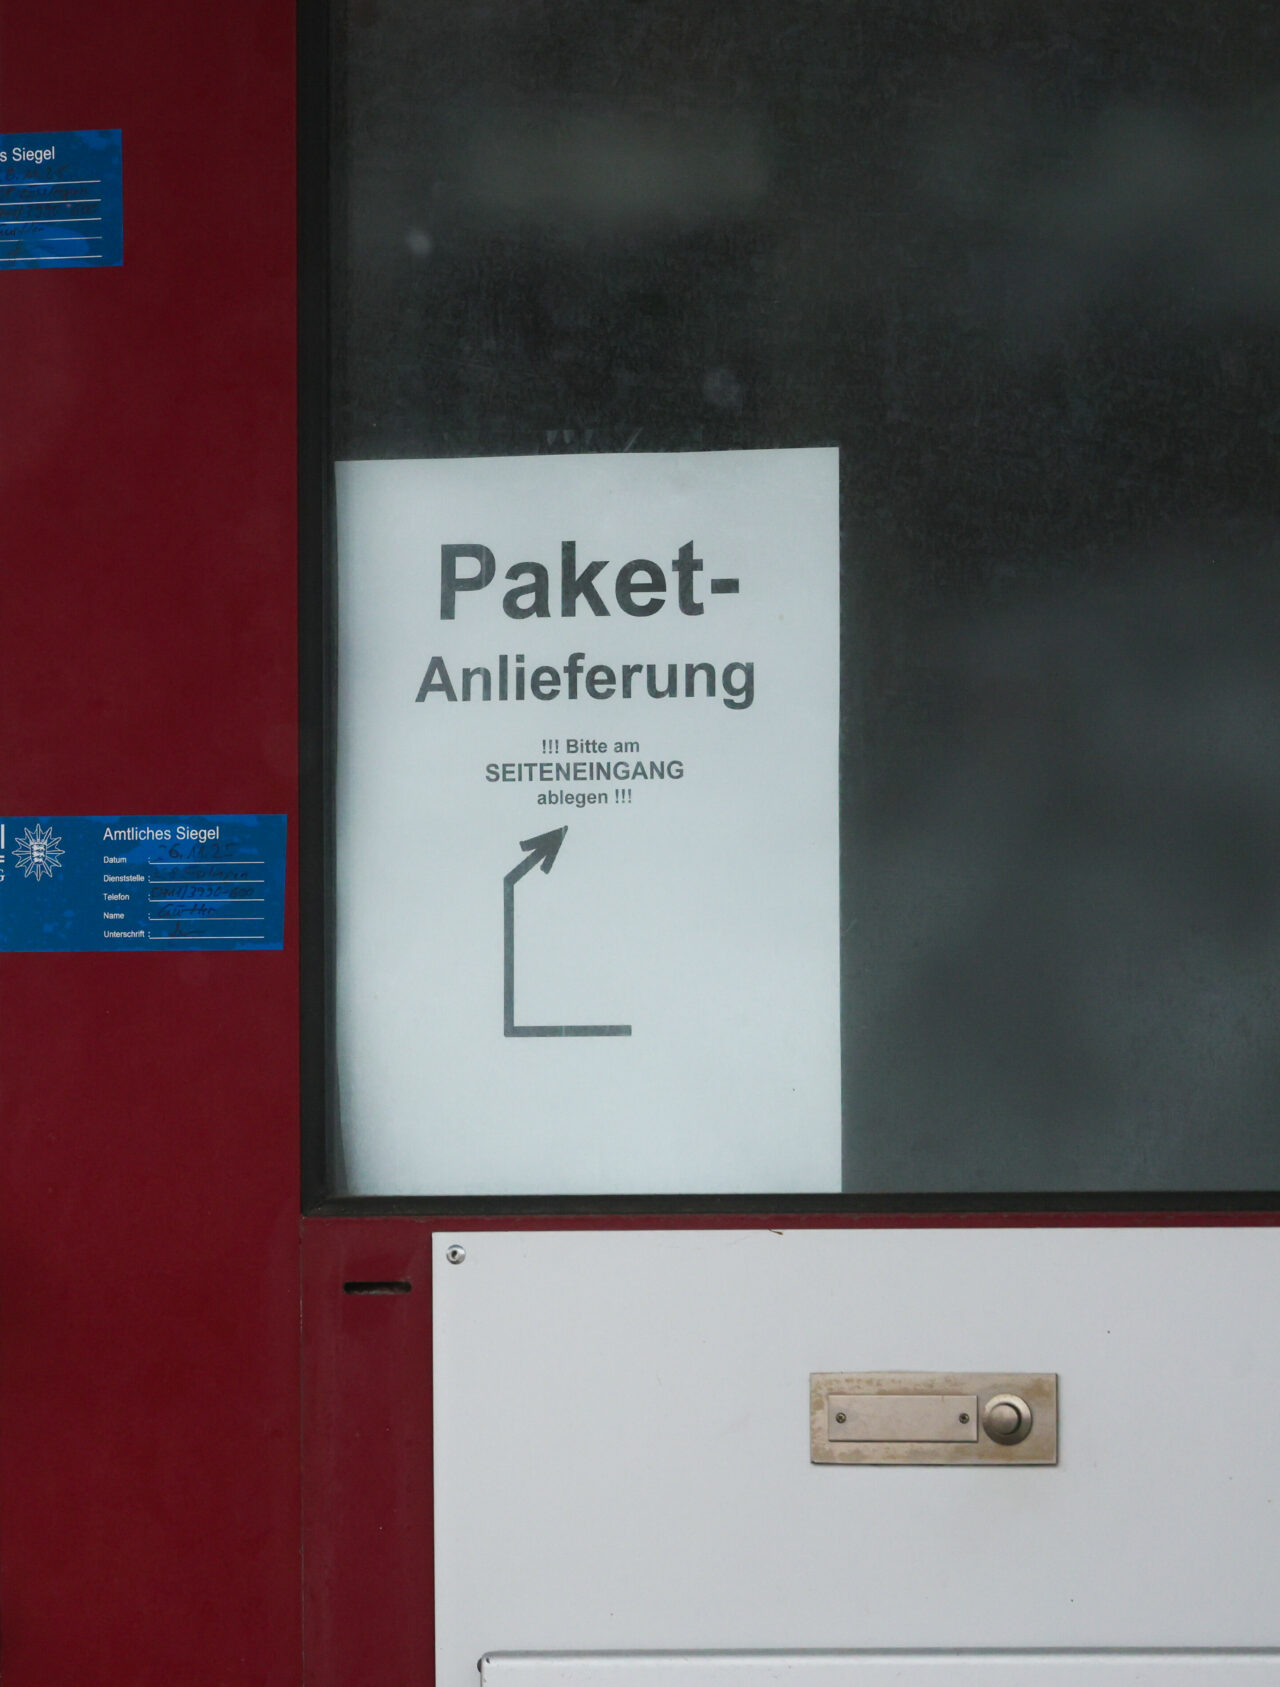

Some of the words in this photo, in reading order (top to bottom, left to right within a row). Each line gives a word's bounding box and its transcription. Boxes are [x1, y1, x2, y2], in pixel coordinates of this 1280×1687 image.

[12, 146, 56, 165] Siegel
[440, 539, 740, 620] Paket-
[415, 652, 755, 710] Anlieferung
[542, 739, 559, 754] !!!
[567, 738, 608, 754] Bitte
[614, 741, 640, 753] am
[485, 760, 684, 782] SEITENEINGANG
[537, 788, 608, 808] ablegen
[615, 788, 632, 804] !!!
[103, 827, 171, 840] Amtliches
[176, 826, 220, 843] Siegel
[103, 856, 127, 864] Datum
[103, 874, 145, 882] Dienststelle
[103, 892, 130, 901] Telefon
[103, 911, 125, 920] Name
[103, 930, 145, 939] Unterschrift
